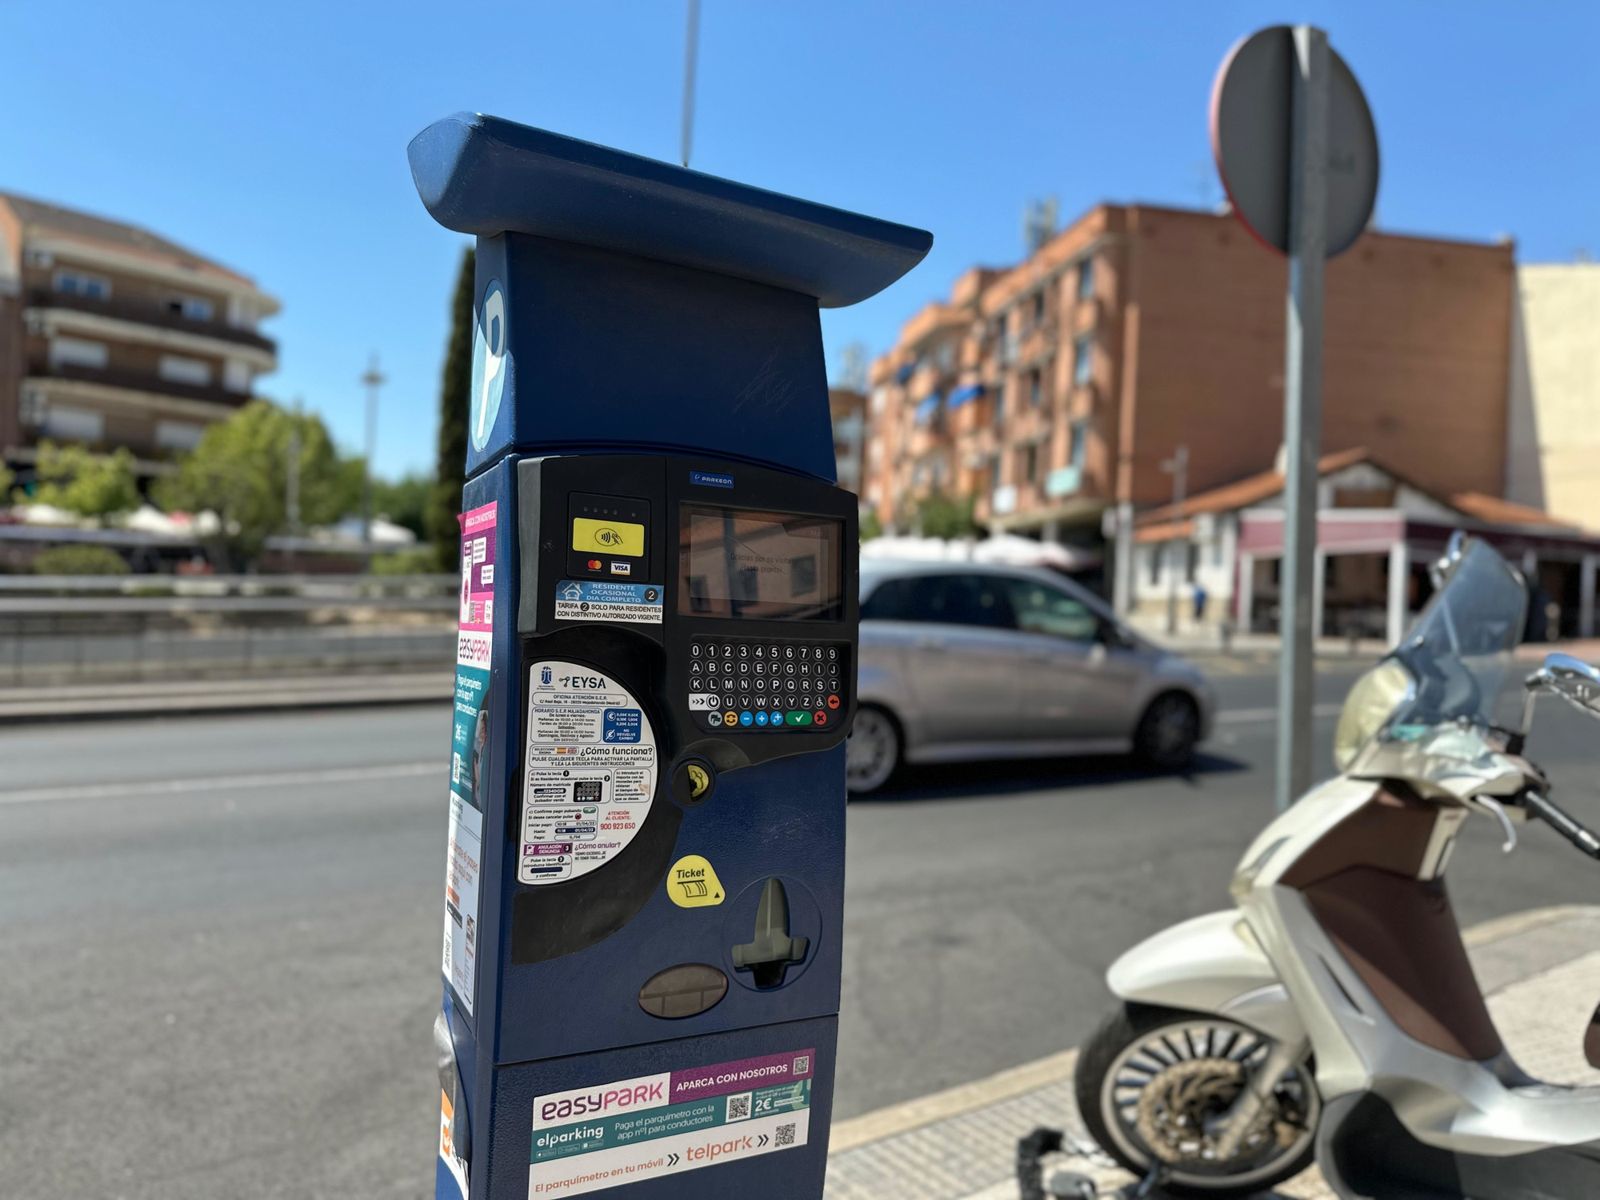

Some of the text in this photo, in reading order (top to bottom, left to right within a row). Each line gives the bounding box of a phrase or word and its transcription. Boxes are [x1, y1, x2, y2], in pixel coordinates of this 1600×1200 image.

[614, 564, 628, 572] VISA
[592, 583, 636, 591] RESIDENTE
[600, 595, 642, 603] COMPLETO
[648, 590, 655, 600] 2
[625, 605, 662, 613] RESIDENTES
[602, 612, 637, 620] AUTORIZADO
[692, 646, 836, 659] 0 1 2 3 4 5 6 7 8 9
[692, 663, 700, 672] A
[708, 663, 716, 672] B
[724, 664, 732, 672] C
[740, 664, 748, 672] D
[756, 664, 763, 672] E
[772, 664, 778, 673] F
[786, 664, 794, 673] G
[801, 665, 808, 674] H
[830, 666, 836, 674] J
[572, 676, 606, 689] EYSA
[693, 680, 837, 690] K L M N O P Q R S T
[726, 698, 810, 706] U V W X Y Z
[580, 746, 653, 756] ¿Cómo funciona?
[613, 822, 623, 830] 923
[676, 868, 704, 879] Ticket
[676, 1064, 788, 1092] APARCA CON NOSOTROS
[755, 1098, 772, 1112] 2€
[614, 1122, 634, 1131] Paga
[635, 1118, 643, 1126] el
[692, 1107, 707, 1115] con
[708, 1104, 715, 1112] la
[617, 1131, 634, 1140] app
[648, 1125, 665, 1135] para
[666, 1115, 714, 1130] conductores
[536, 1126, 604, 1148] elparking
[686, 1136, 752, 1161] telpark
[535, 1158, 664, 1192] El parquímetro en tu móvil
